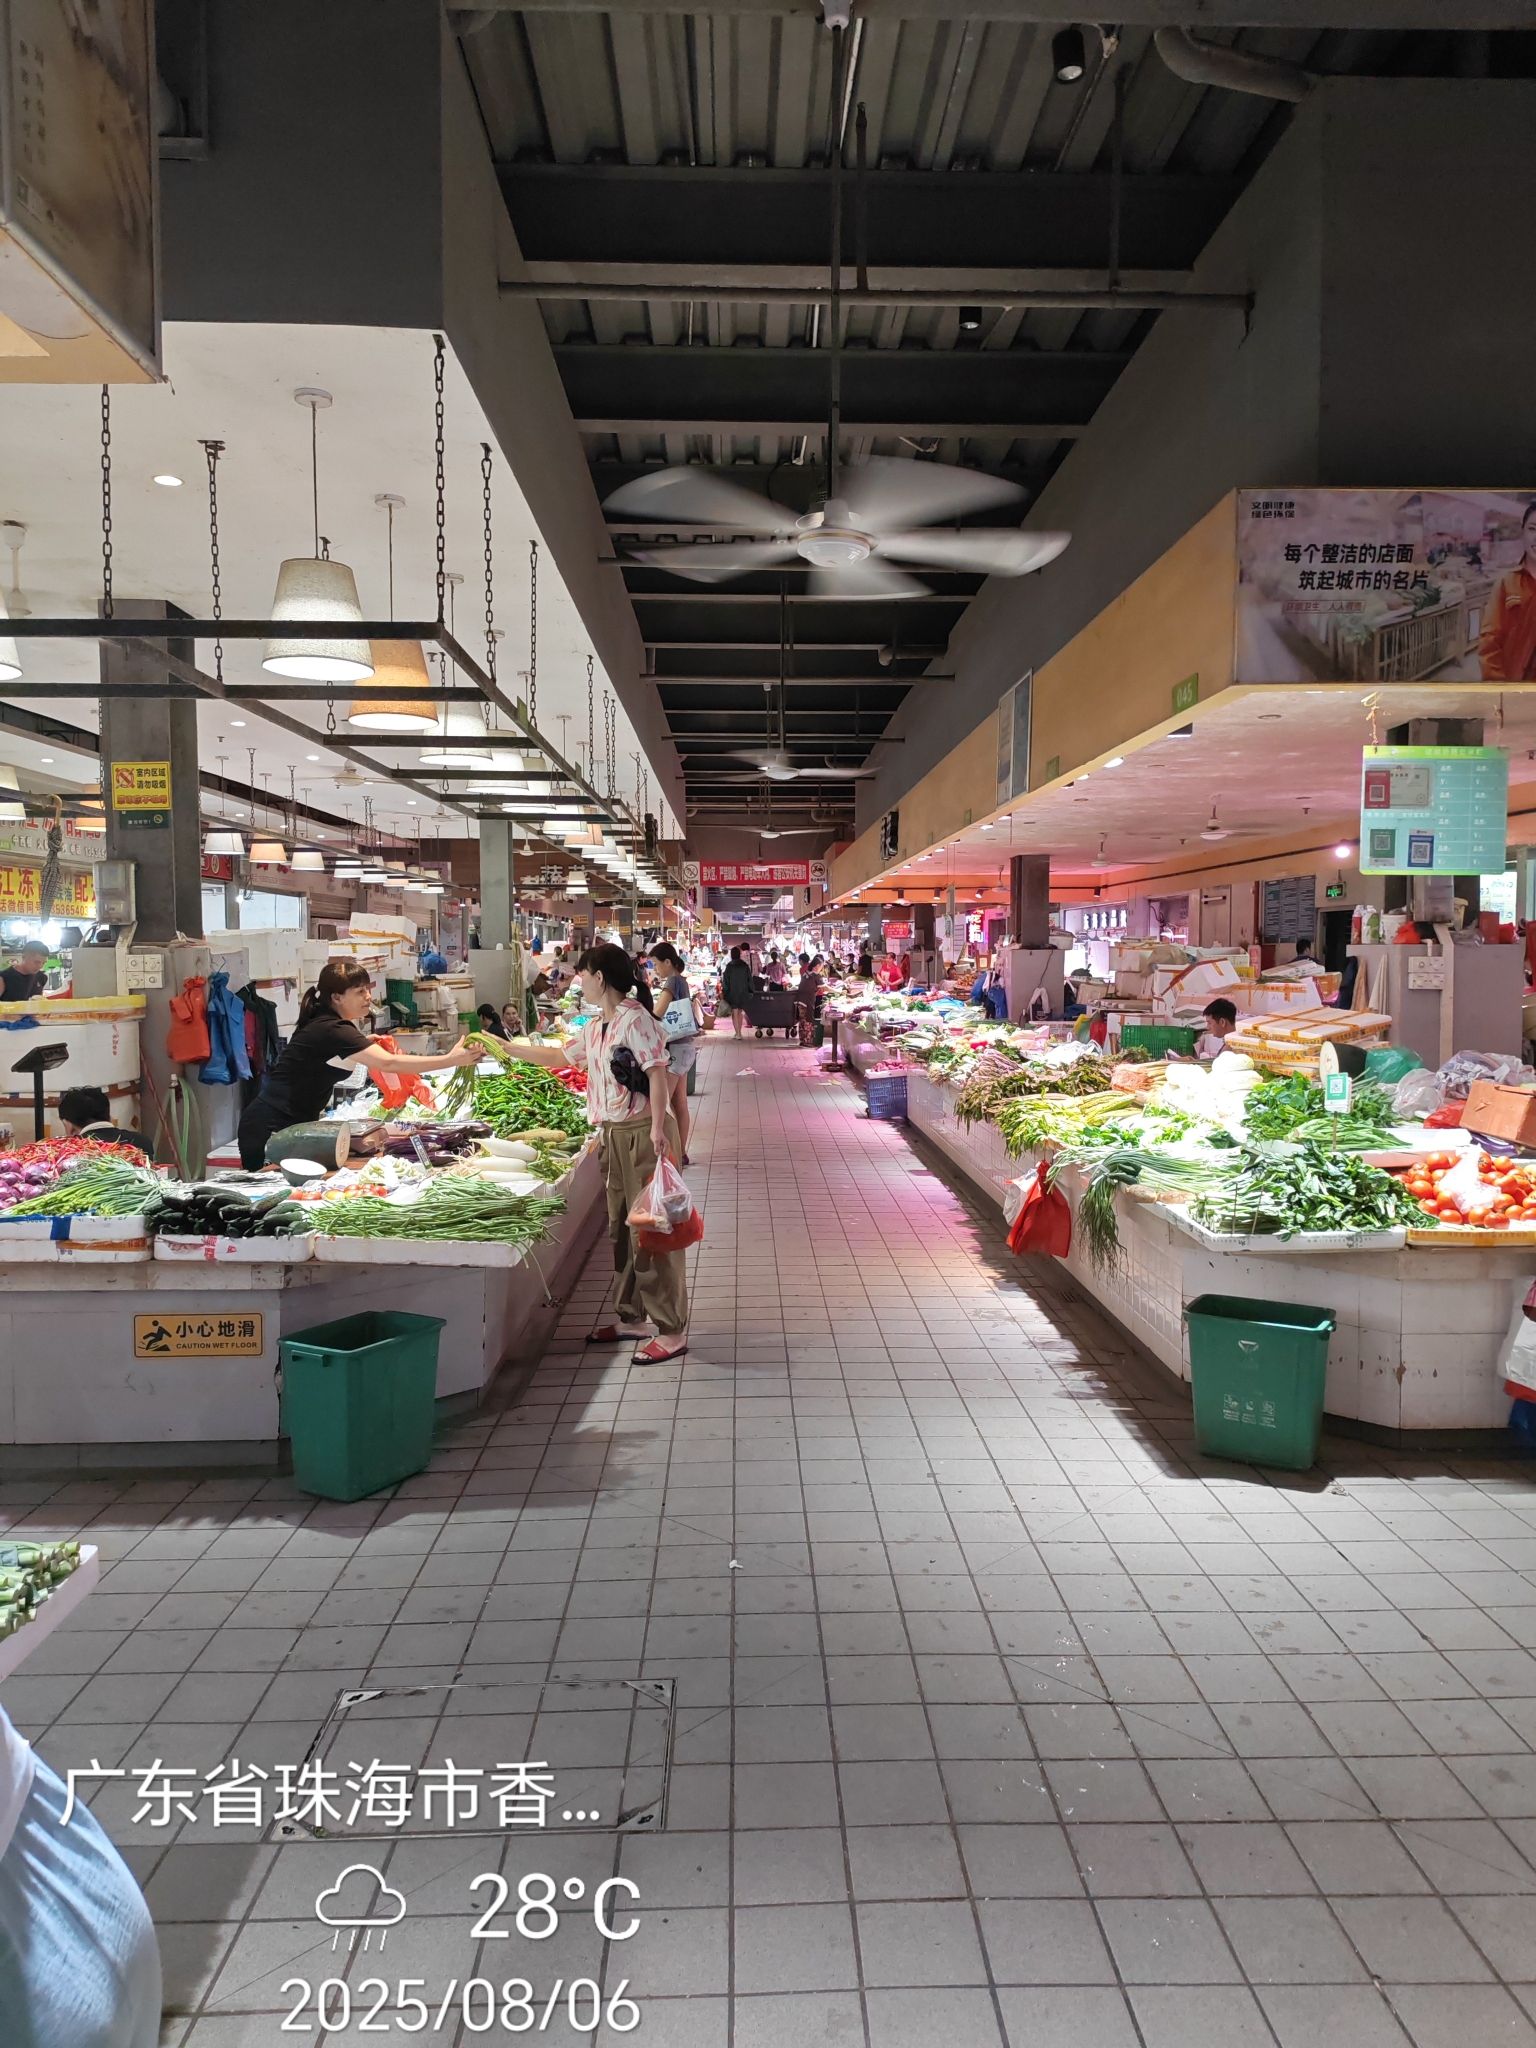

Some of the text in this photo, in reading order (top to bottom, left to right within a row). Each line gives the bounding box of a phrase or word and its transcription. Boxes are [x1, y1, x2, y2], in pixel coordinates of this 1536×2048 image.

[1251, 501, 1295, 510] 文明健康
[1251, 510, 1295, 519] 绿色环保
[1284, 543, 1415, 565] 每个整洁的店面
[1299, 570, 1429, 591] 筑起城市的名片
[136, 767, 166, 777] 室内区域
[137, 780, 167, 789] 请勿吸烟
[176, 1321, 255, 1338] 小心地滑
[176, 1342, 211, 1350] CAUTION
